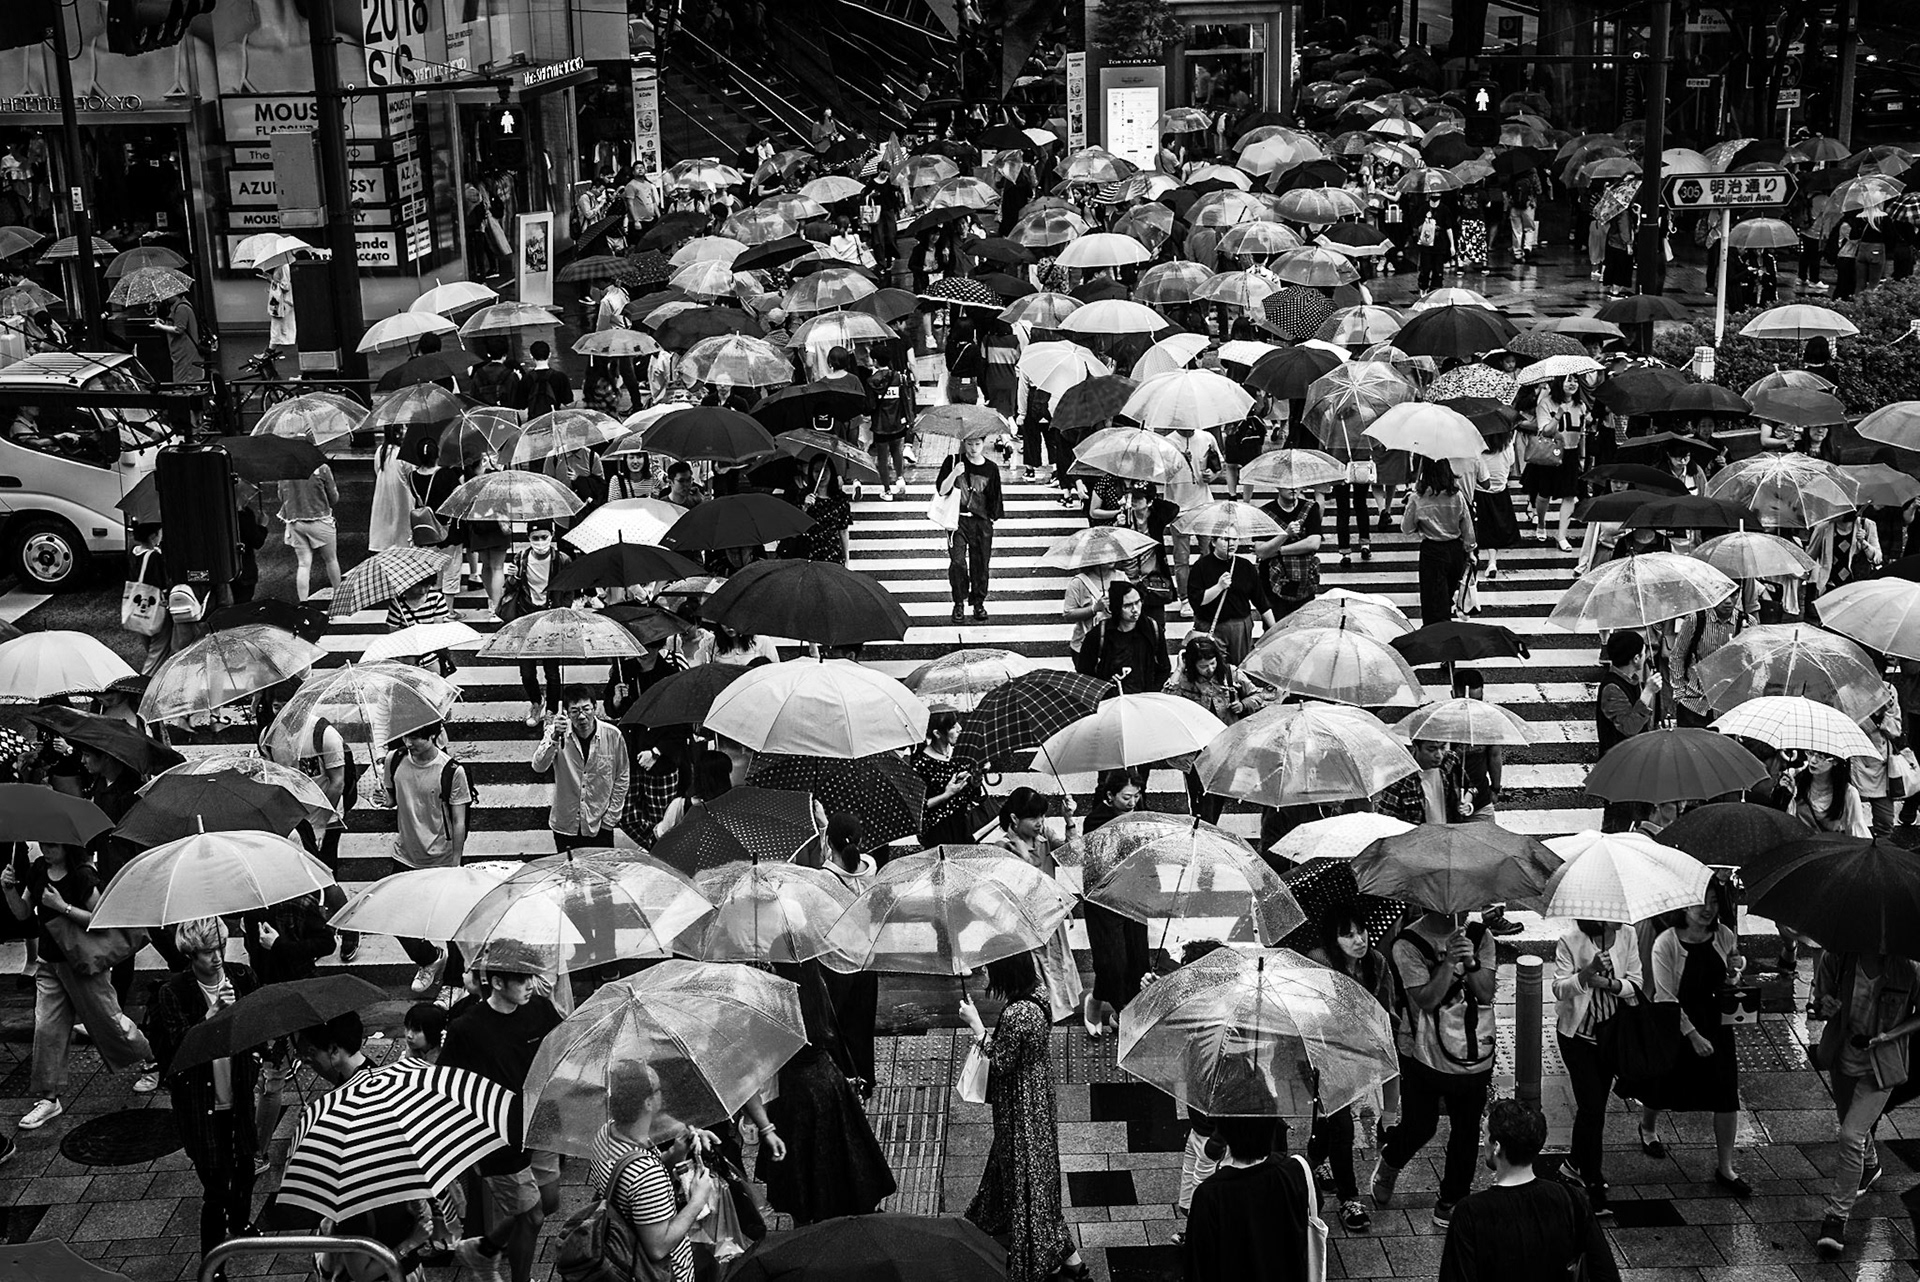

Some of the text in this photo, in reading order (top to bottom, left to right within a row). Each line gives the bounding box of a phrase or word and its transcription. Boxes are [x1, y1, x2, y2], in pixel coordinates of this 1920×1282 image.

[363, 0, 428, 44] 2018
[250, 151, 270, 160] The
[1680, 185, 1701, 198] 305
[1709, 178, 1778, 195] 明治通り
[1713, 193, 1774, 204] Meiji-dori Ave.
